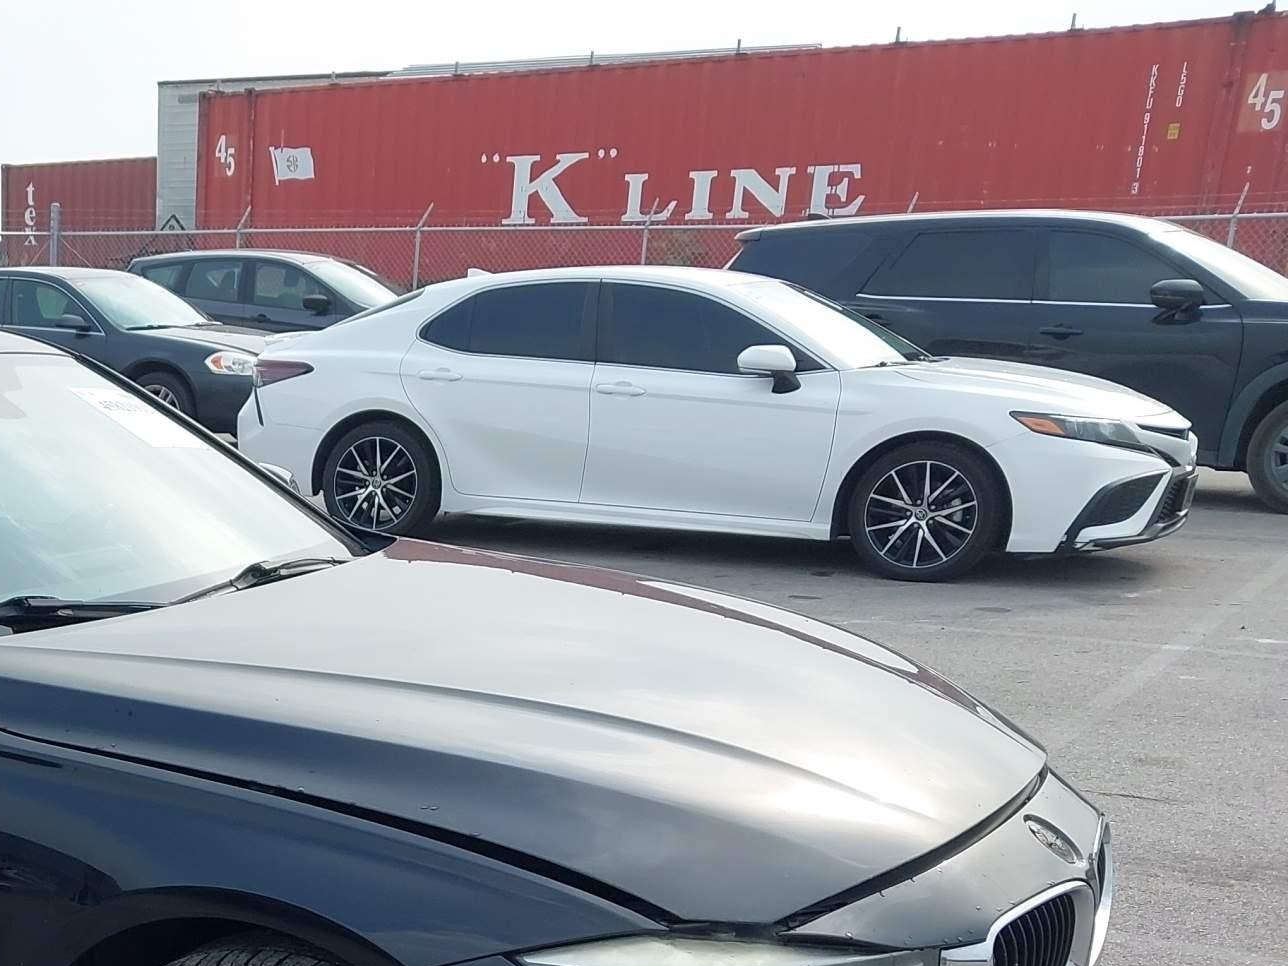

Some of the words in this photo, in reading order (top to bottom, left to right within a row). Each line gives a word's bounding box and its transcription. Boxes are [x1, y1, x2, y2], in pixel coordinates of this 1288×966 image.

[1247, 72, 1285, 130] 45
[215, 135, 236, 177] 45
[1136, 112, 1150, 178] 911801
[621, 163, 866, 222] LINE
